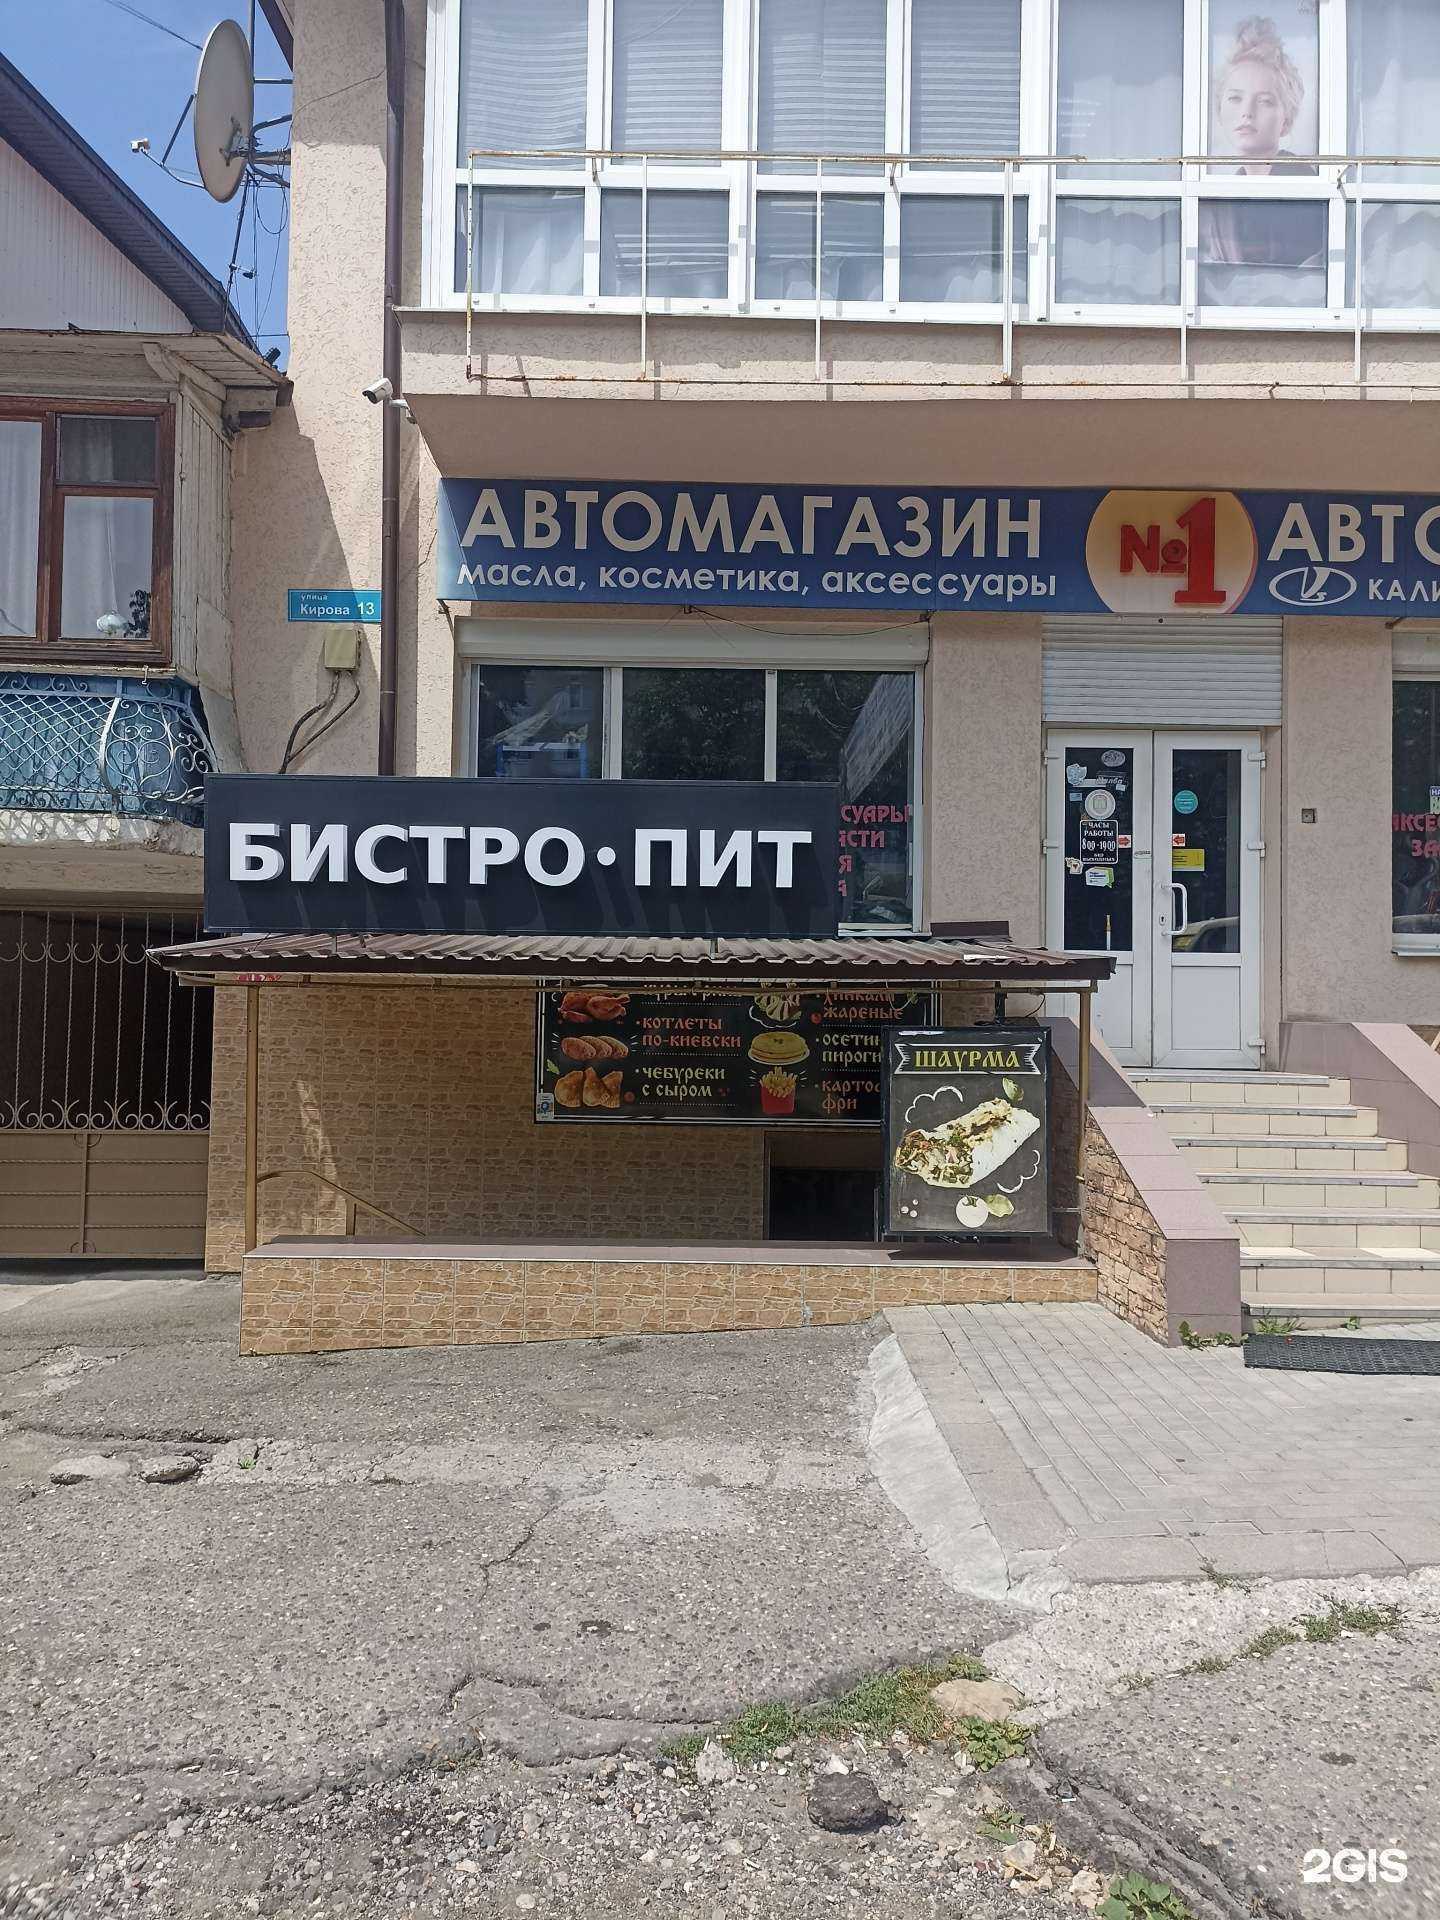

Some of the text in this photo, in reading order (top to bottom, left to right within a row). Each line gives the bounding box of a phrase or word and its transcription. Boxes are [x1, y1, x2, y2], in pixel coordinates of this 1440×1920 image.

[460, 488, 1041, 559] АВТОМАГАЗИН
[301, 593, 328, 601] улица
[457, 563, 1056, 602] масла, косметика, аксессуары
[301, 602, 375, 617] Кирова 13
[229, 822, 813, 889] БИСТРО ПИТ
[915, 1050, 1021, 1072] ШАУРМА
